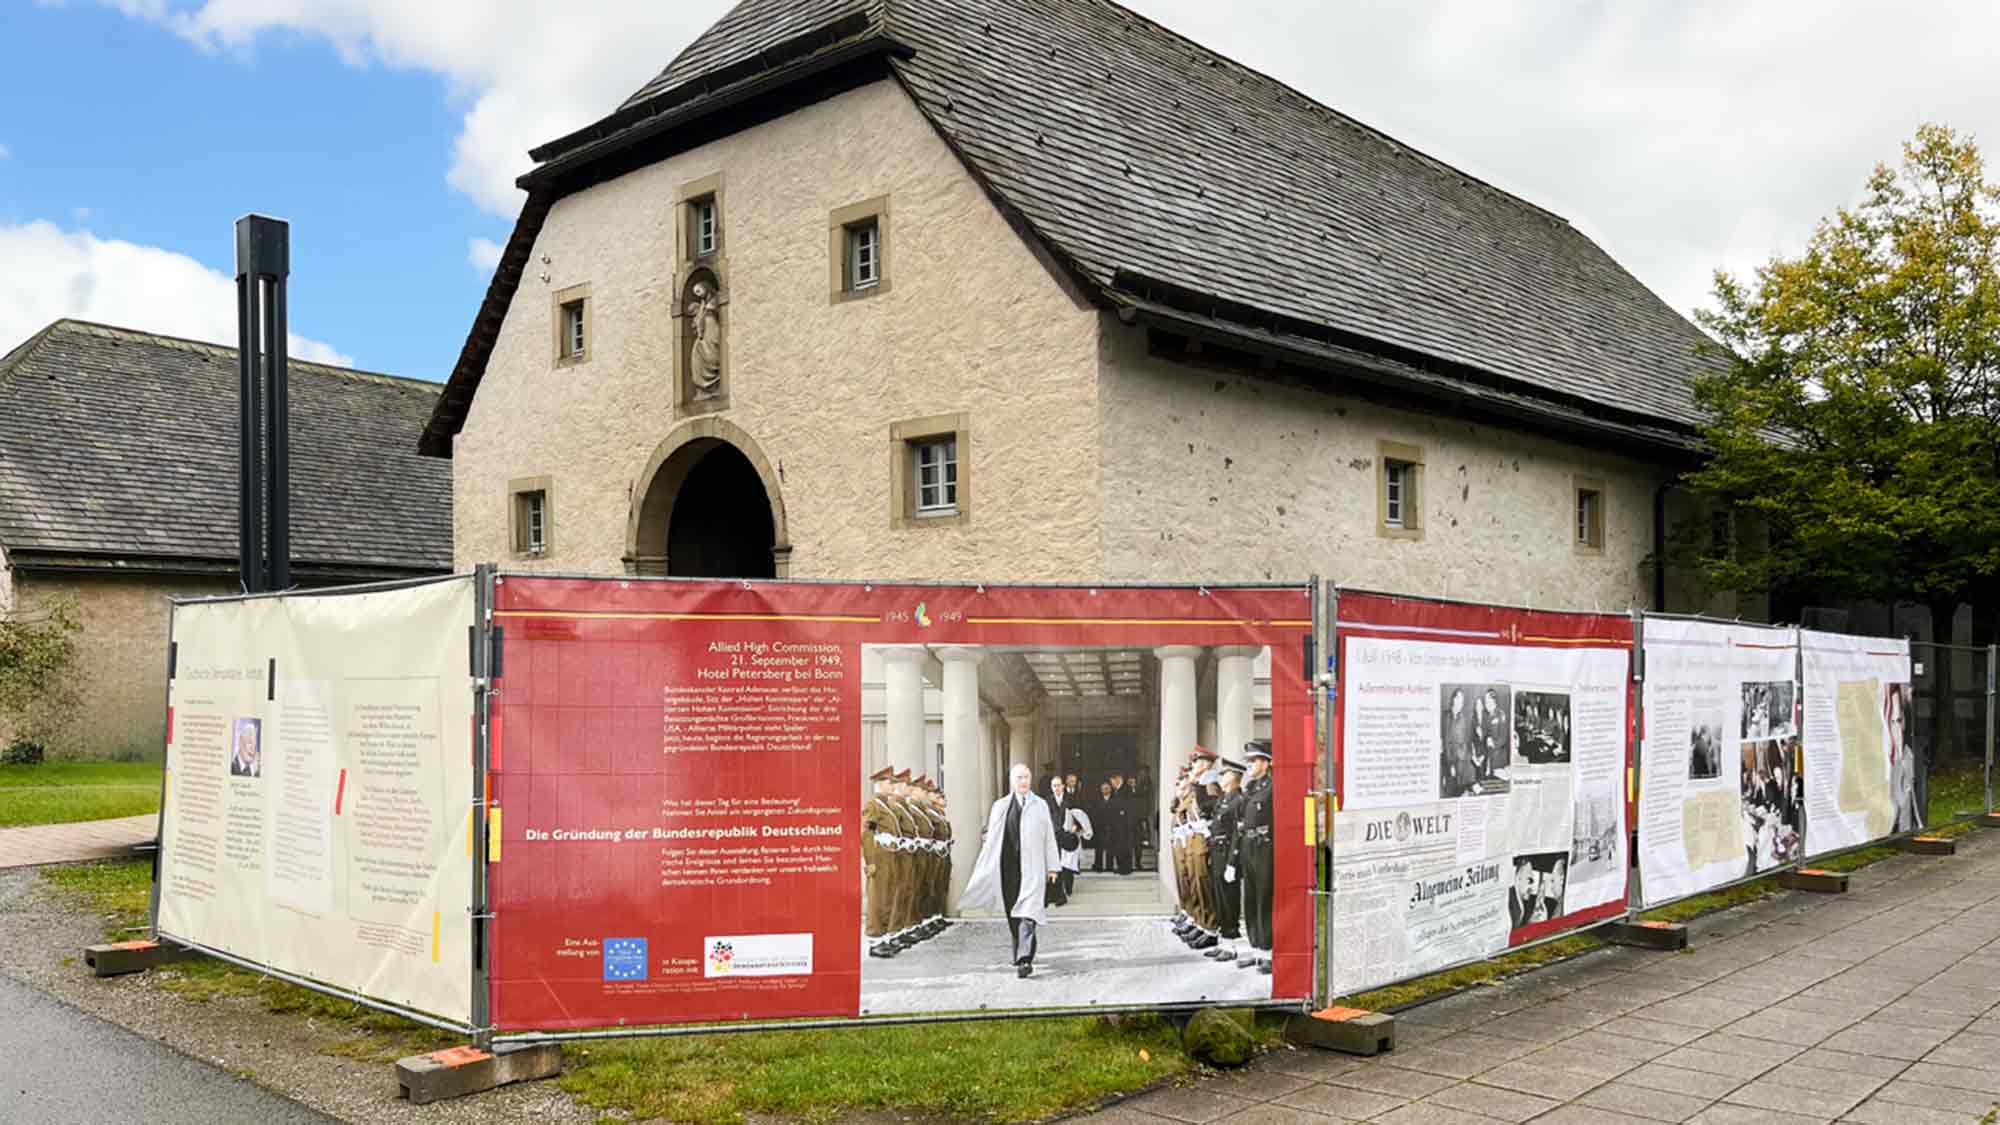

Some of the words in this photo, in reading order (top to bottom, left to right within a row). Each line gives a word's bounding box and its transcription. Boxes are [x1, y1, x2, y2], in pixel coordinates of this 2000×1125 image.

[709, 642, 741, 653] Allied
[744, 642, 768, 655] High
[772, 642, 843, 654] Commission,
[731, 656, 749, 666] 21.
[751, 656, 808, 668] September
[815, 656, 843, 667] 1949,
[697, 669, 729, 680] Hotel
[732, 669, 792, 682] Petersberg
[795, 669, 812, 680] bei
[815, 669, 844, 680] Bonn
[526, 828, 549, 840] Die
[552, 828, 622, 843] Gründung
[625, 827, 649, 840] der
[653, 826, 758, 840] Bundesrepublik
[762, 823, 843, 838] Deutschland
[1364, 820, 1393, 841] DIE
[1412, 815, 1451, 835] WELT
